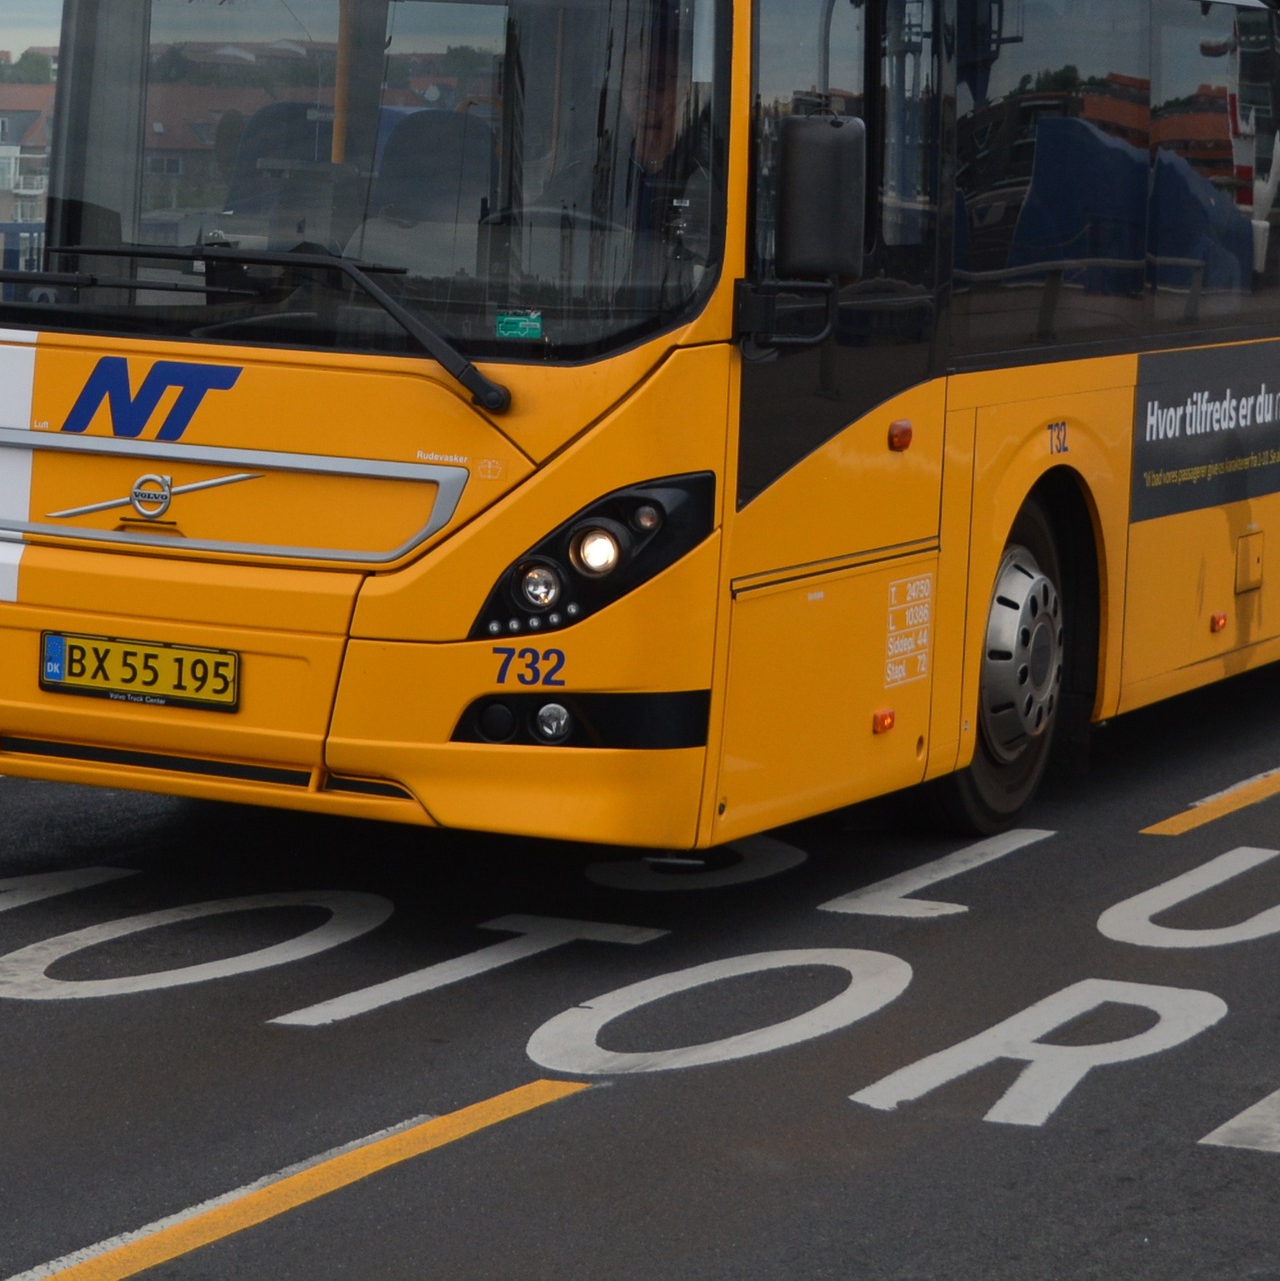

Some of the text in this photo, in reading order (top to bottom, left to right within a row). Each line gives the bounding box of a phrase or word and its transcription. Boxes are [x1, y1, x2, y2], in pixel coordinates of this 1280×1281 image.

[60, 356, 244, 441] NT
[1146, 401, 1183, 441] Hvor
[1185, 388, 1236, 436] tilfreds
[1238, 396, 1255, 427] er
[1255, 383, 1274, 424] du
[416, 450, 468, 463] Rudevasker
[1047, 421, 1069, 455] 732
[133, 490, 168, 501] VOLVO
[47, 662, 60, 674] DK
[68, 645, 230, 695] BX 55 195
[492, 647, 566, 687] 732
